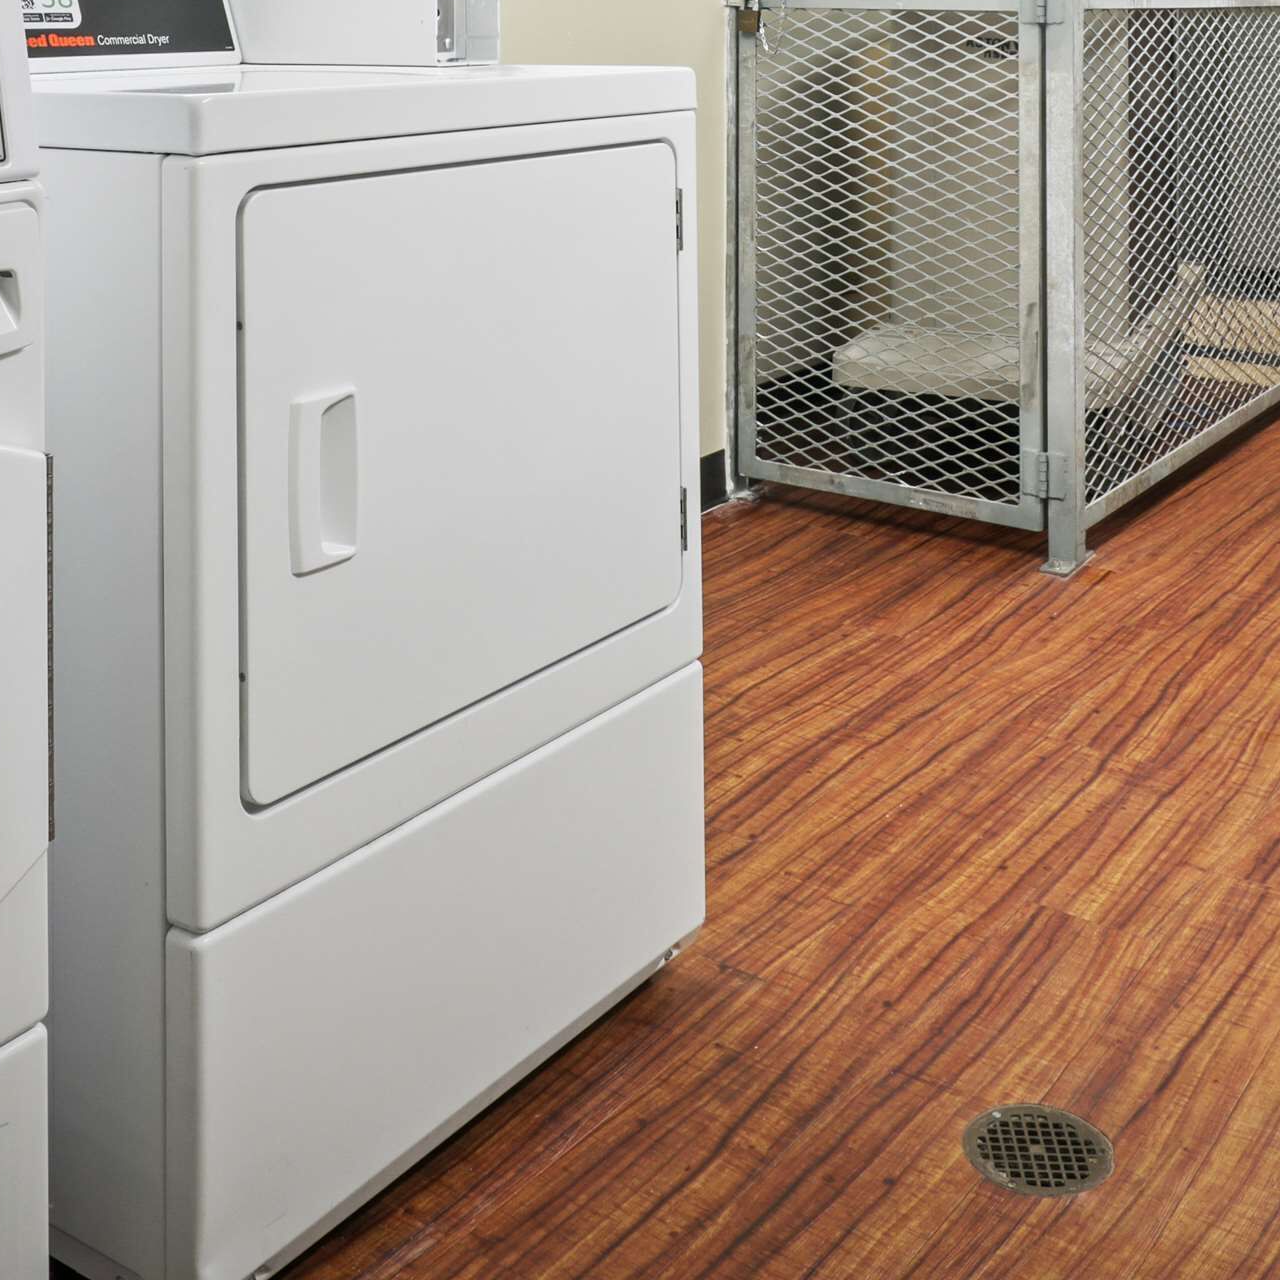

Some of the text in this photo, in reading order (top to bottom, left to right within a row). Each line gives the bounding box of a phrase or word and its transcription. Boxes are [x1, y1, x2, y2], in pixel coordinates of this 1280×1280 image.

[48, 33, 96, 48] Queen
[97, 33, 147, 47] Commercial
[147, 33, 170, 48] Dryer
